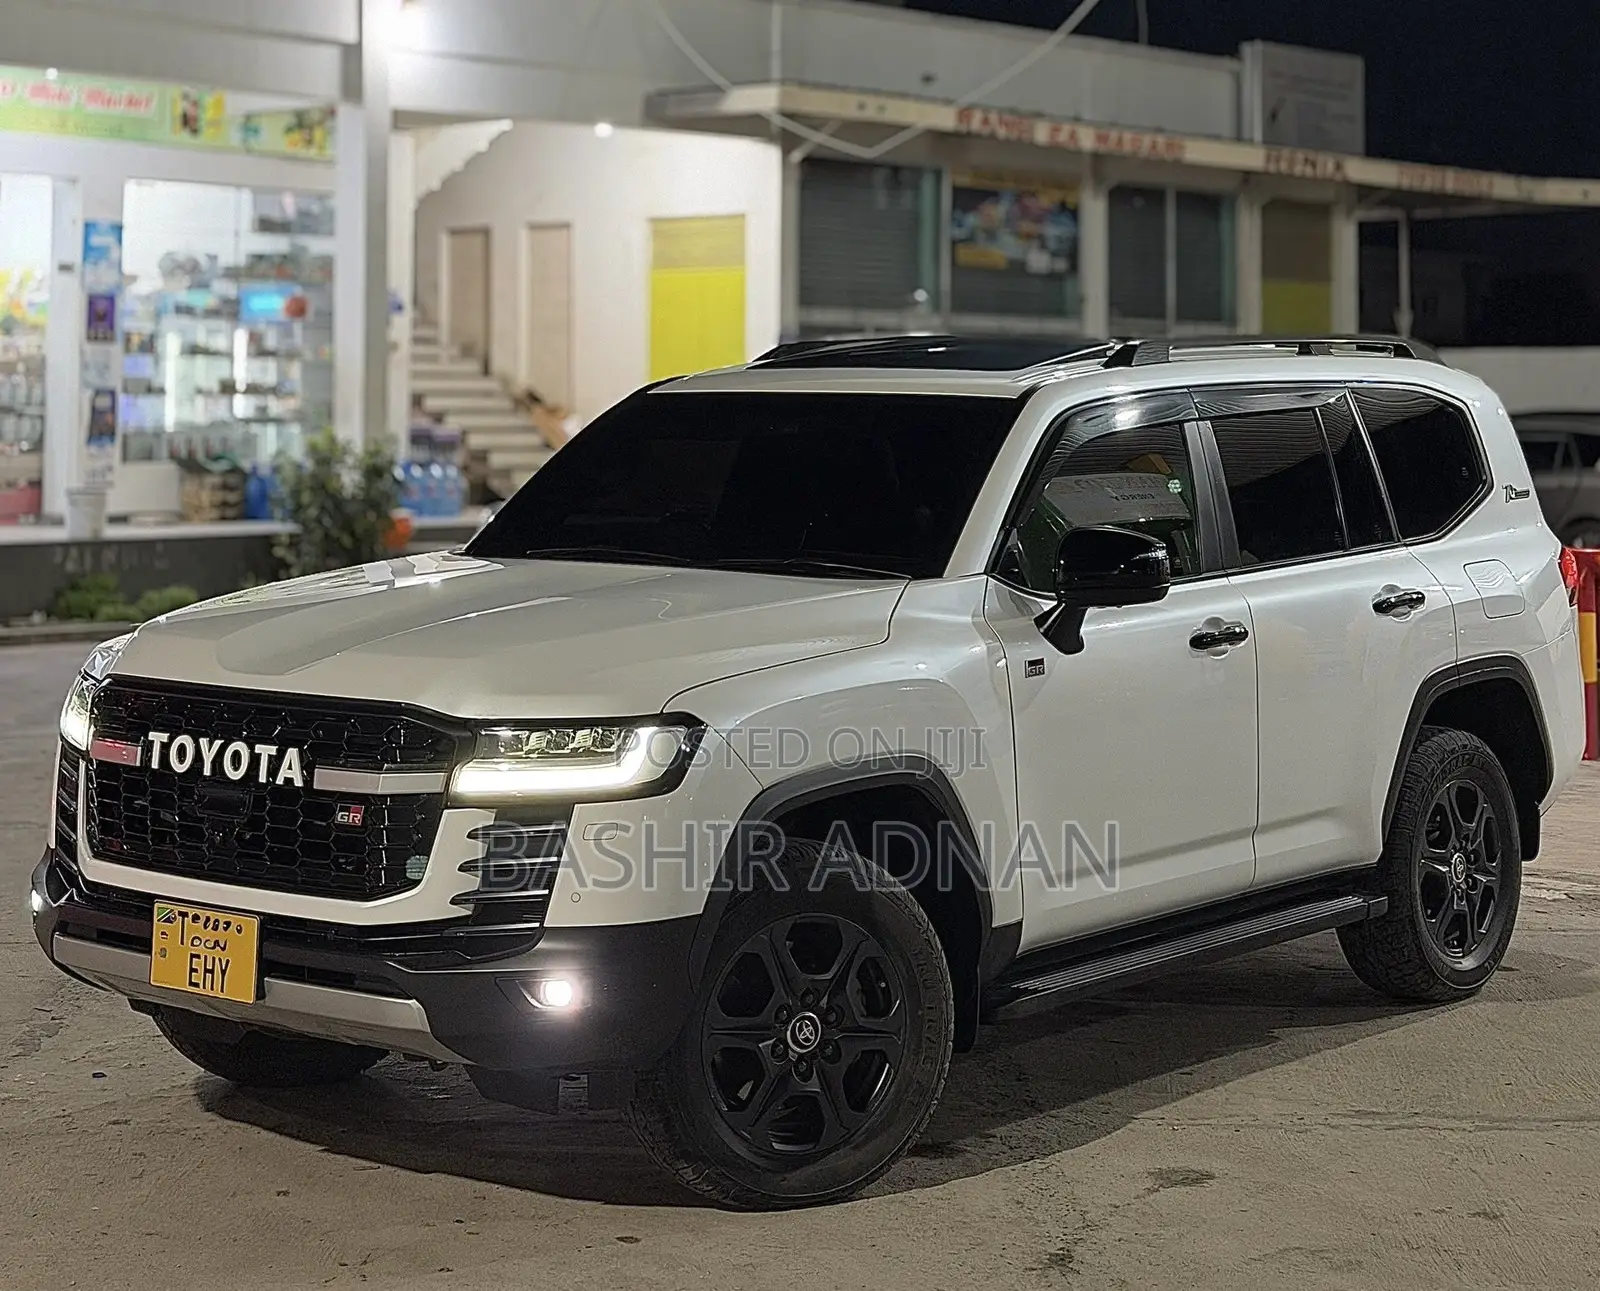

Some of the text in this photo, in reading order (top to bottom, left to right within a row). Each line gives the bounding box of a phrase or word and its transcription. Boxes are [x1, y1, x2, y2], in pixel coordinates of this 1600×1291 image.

[147, 731, 304, 787] TOYOTA
[336, 808, 361, 825] GR
[188, 952, 231, 993] EHY
